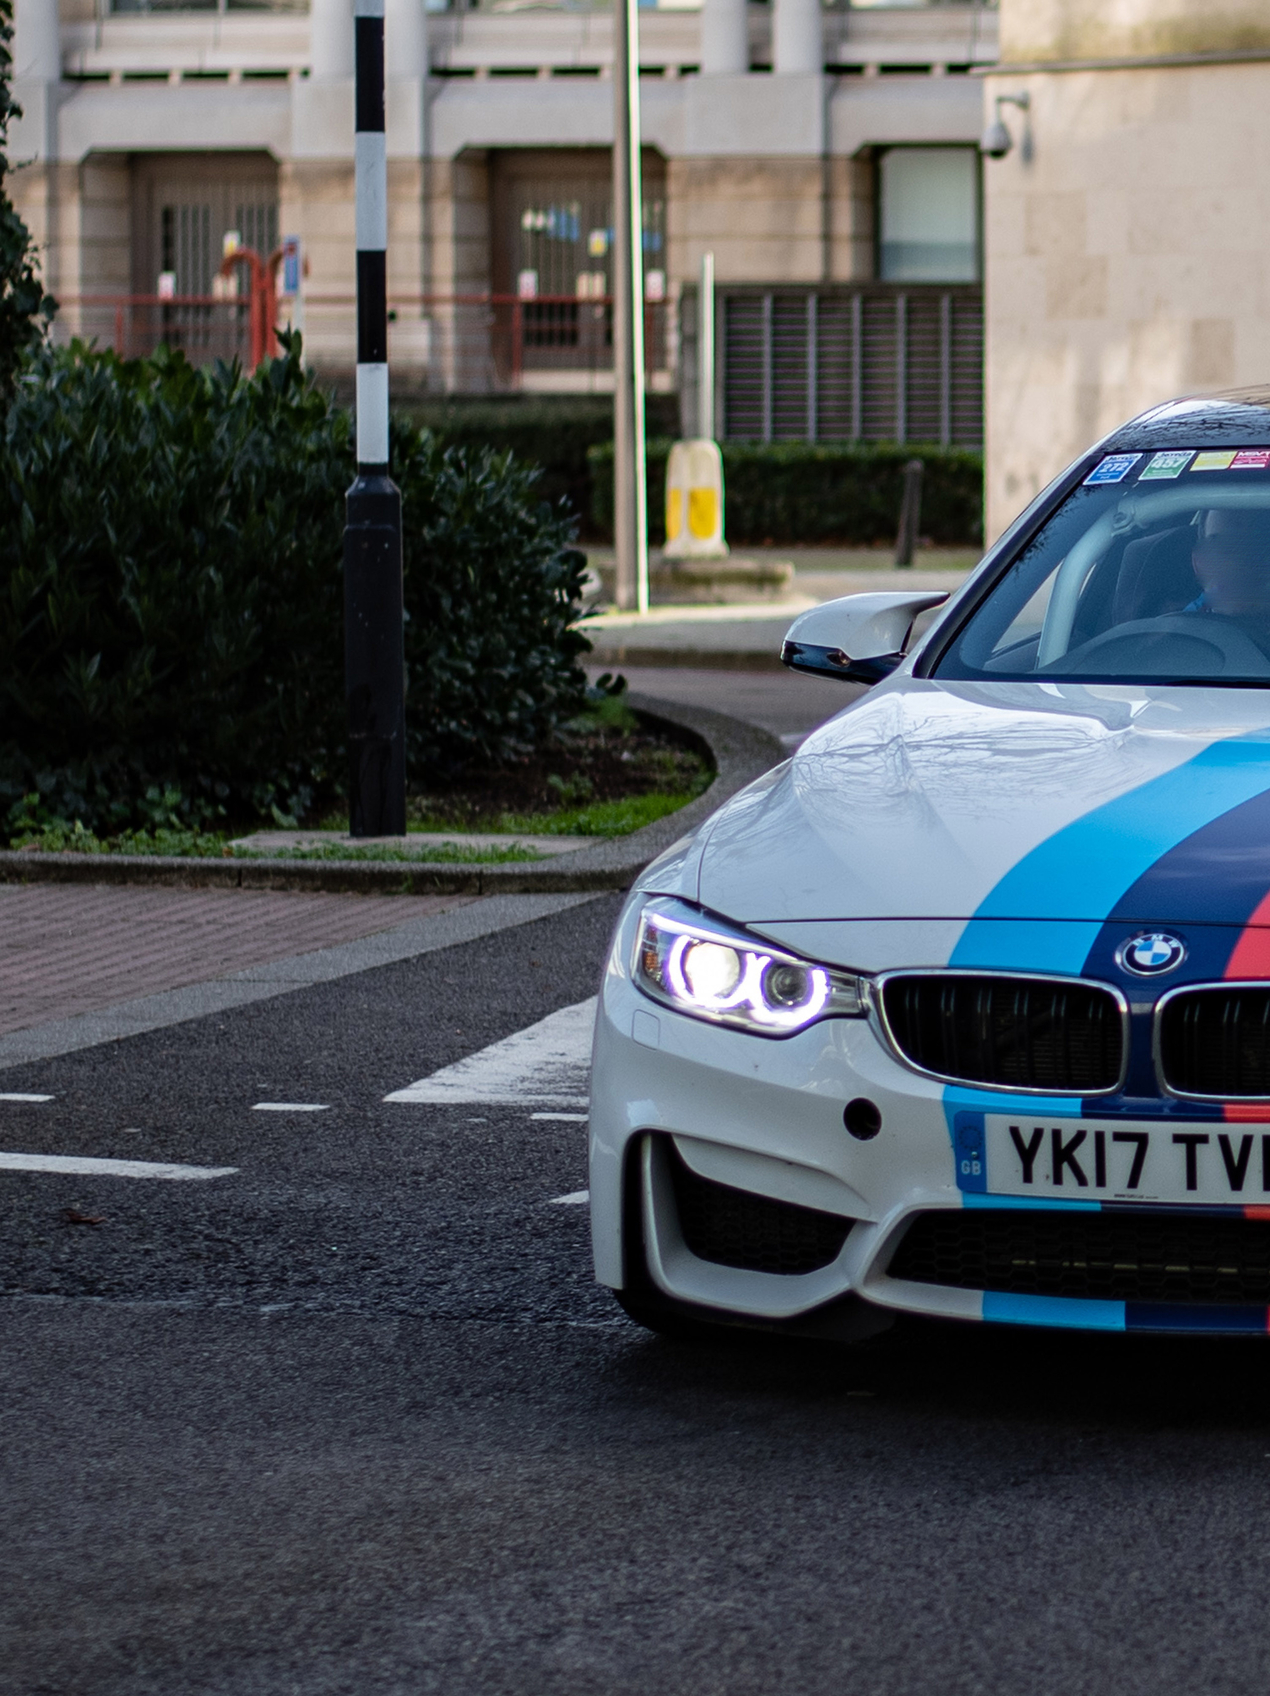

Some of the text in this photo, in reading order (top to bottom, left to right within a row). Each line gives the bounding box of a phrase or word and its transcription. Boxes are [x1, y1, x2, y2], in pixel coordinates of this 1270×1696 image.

[1099, 462, 1130, 472] 272
[1132, 934, 1181, 949] BMW
[1008, 1126, 1150, 1189] YK17
[961, 1159, 982, 1176] GB
